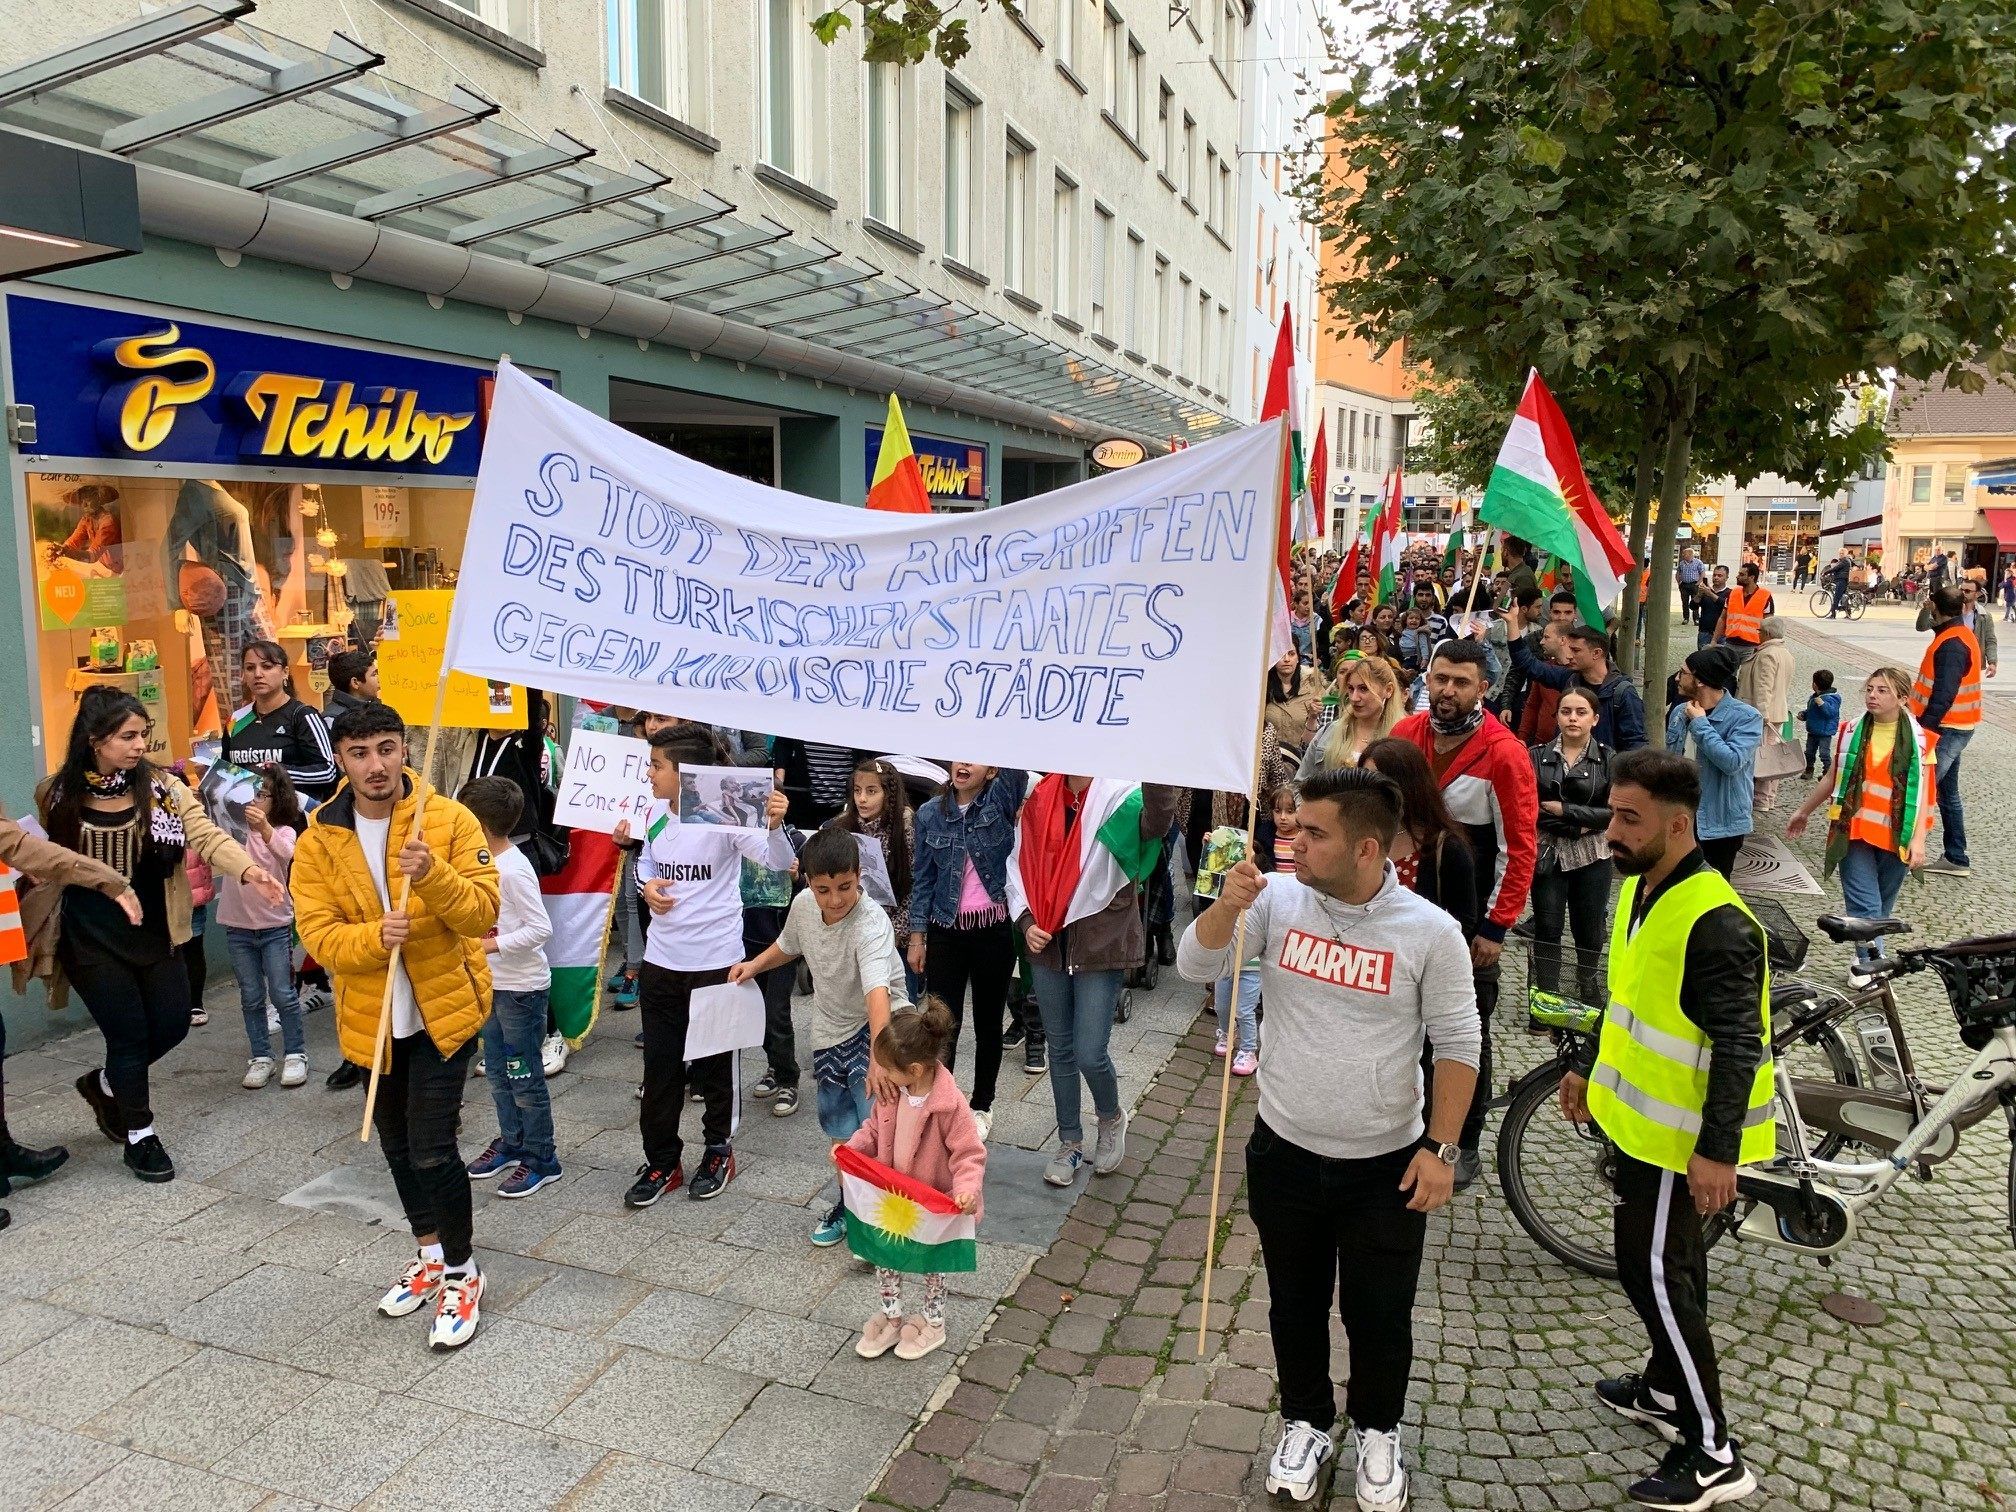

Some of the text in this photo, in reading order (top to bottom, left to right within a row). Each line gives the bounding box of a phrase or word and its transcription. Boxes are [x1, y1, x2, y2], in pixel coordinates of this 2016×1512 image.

[244, 372, 475, 464] Tchibo
[917, 453, 972, 495] Tchibo
[1098, 446, 1137, 460] Denim
[738, 528, 866, 592] DEN
[887, 489, 1257, 592] ANGRIFFEN
[54, 585, 76, 598] NEU
[404, 602, 439, 628] Save
[503, 523, 606, 603] DES
[924, 583, 1184, 661] STAATES
[494, 601, 661, 681] GEGEN
[935, 658, 1145, 726] STÄDTE
[1281, 931, 1387, 992] MARVEL
